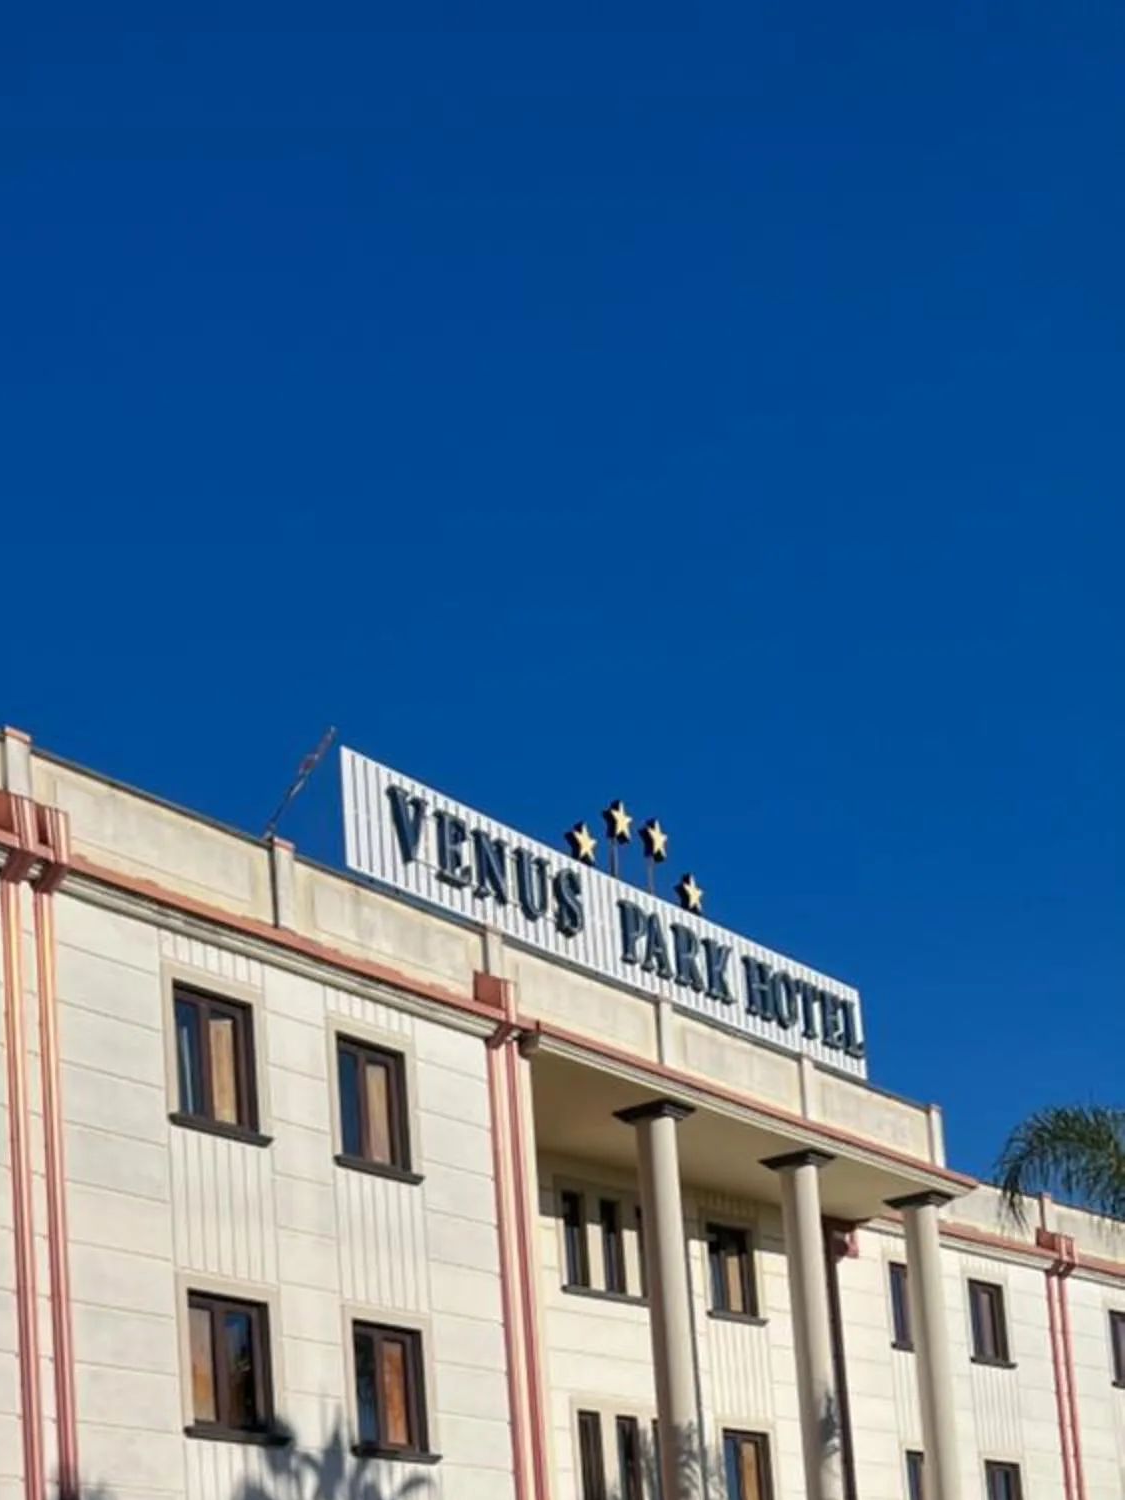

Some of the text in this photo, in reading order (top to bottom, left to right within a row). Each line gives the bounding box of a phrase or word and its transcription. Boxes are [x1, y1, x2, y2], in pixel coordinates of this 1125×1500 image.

[386, 784, 865, 1058] VENUS PARK HOTEL
